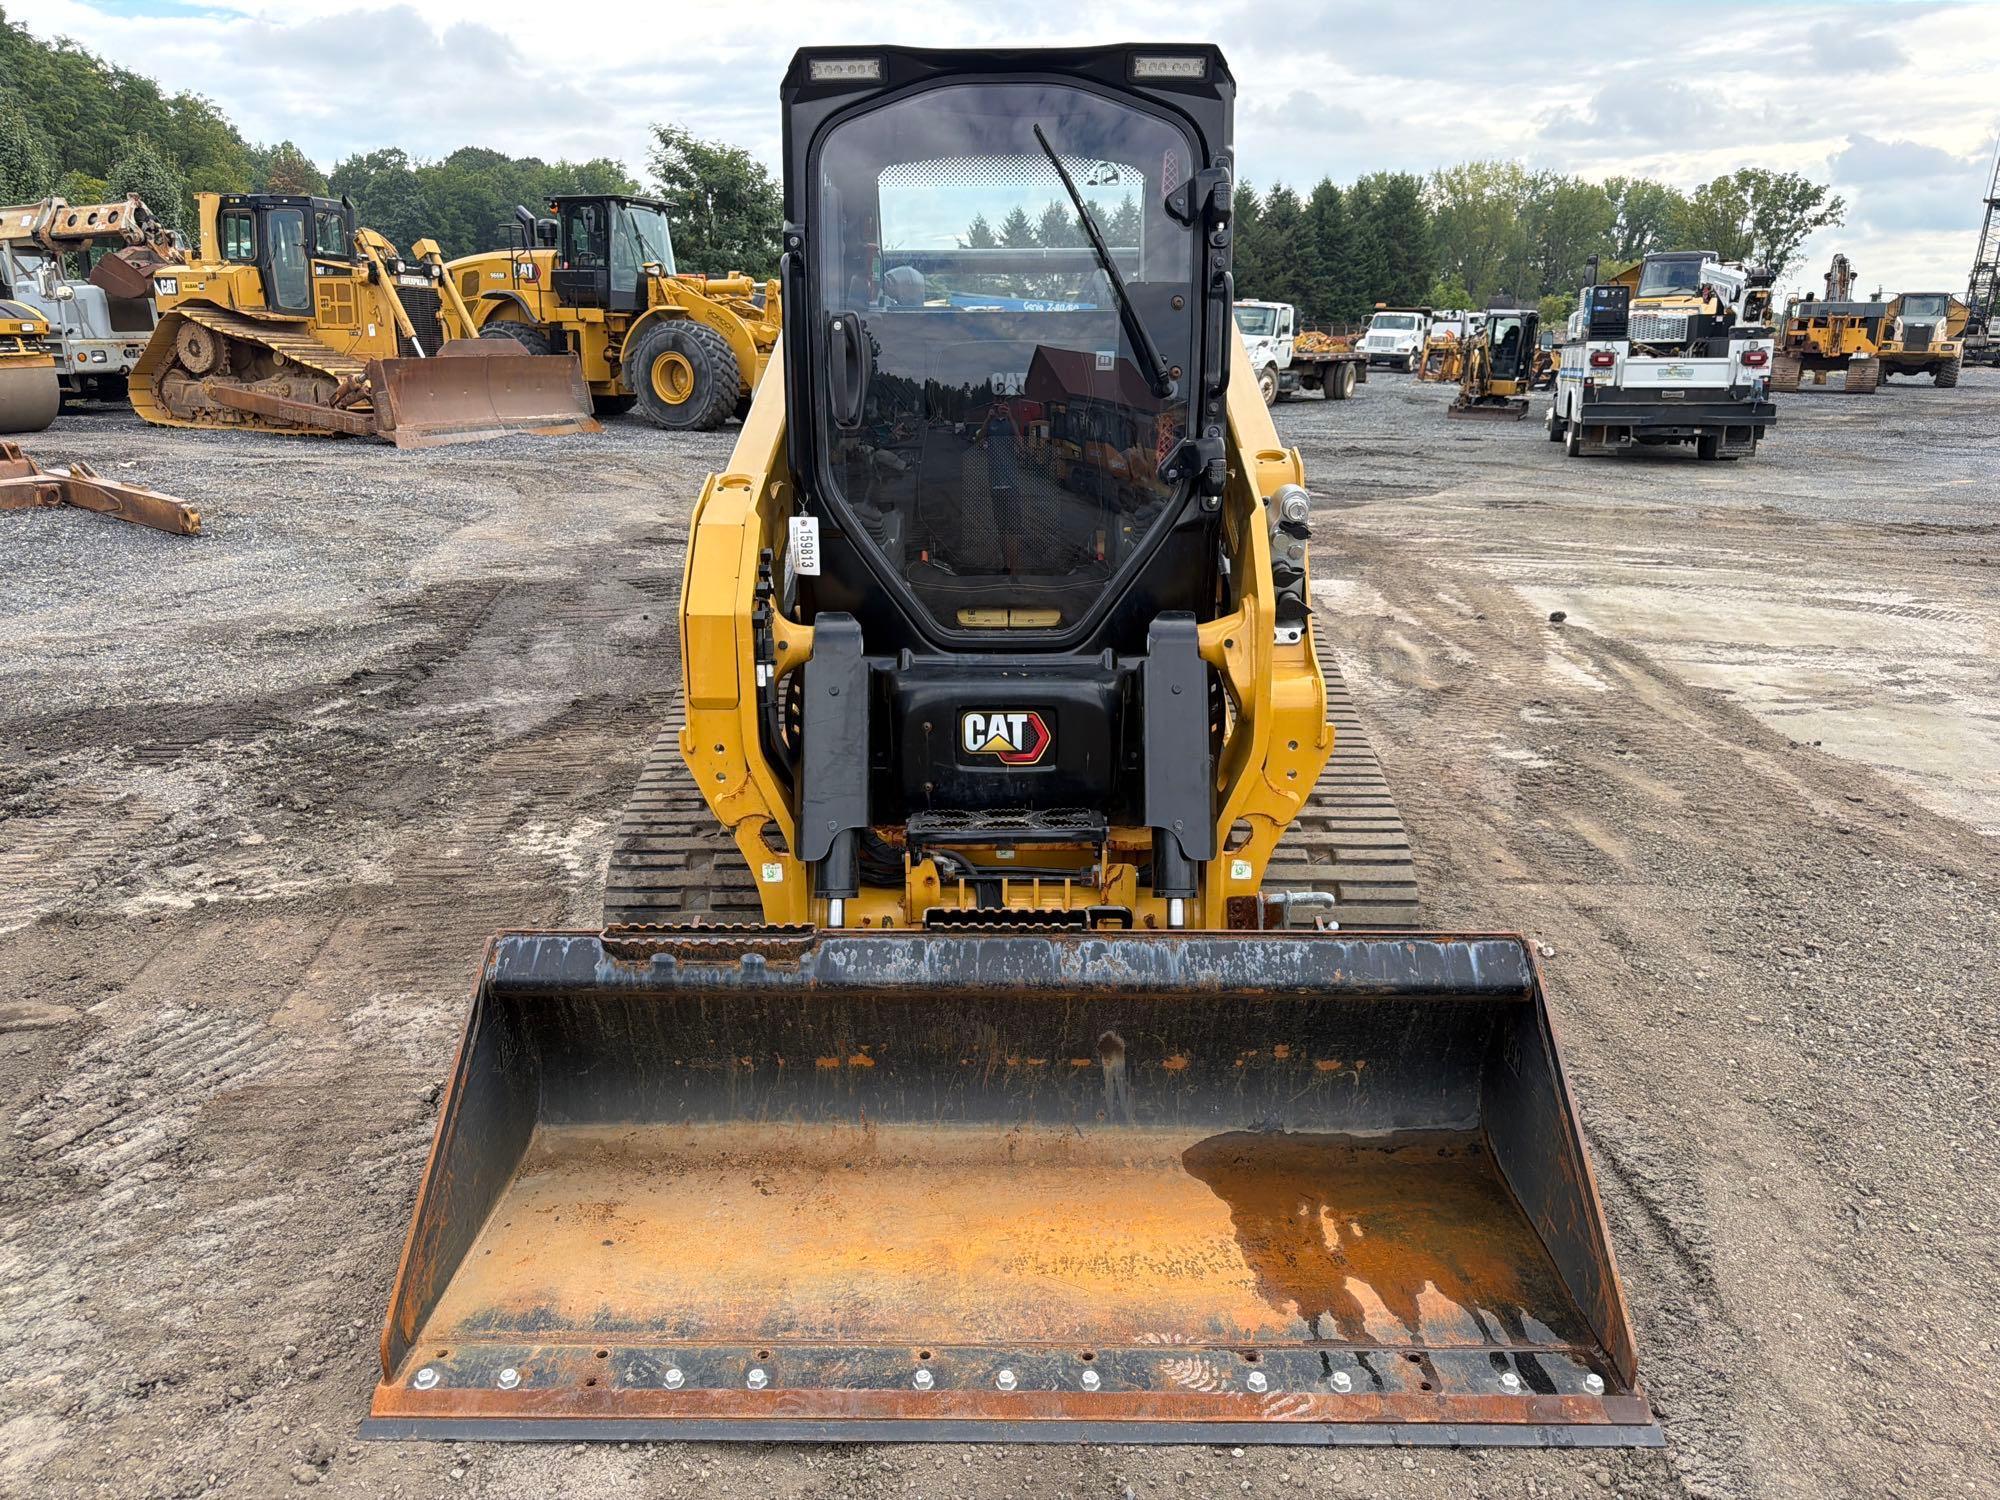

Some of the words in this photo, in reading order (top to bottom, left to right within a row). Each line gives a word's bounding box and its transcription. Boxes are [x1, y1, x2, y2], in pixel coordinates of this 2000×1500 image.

[160, 279, 177, 294] CAT
[400, 276, 429, 287] CATERPILLAR
[1023, 301, 1044, 311] Genie
[991, 372, 1027, 396] CAT
[800, 529, 815, 568] 159813
[964, 713, 1028, 751] CAT
